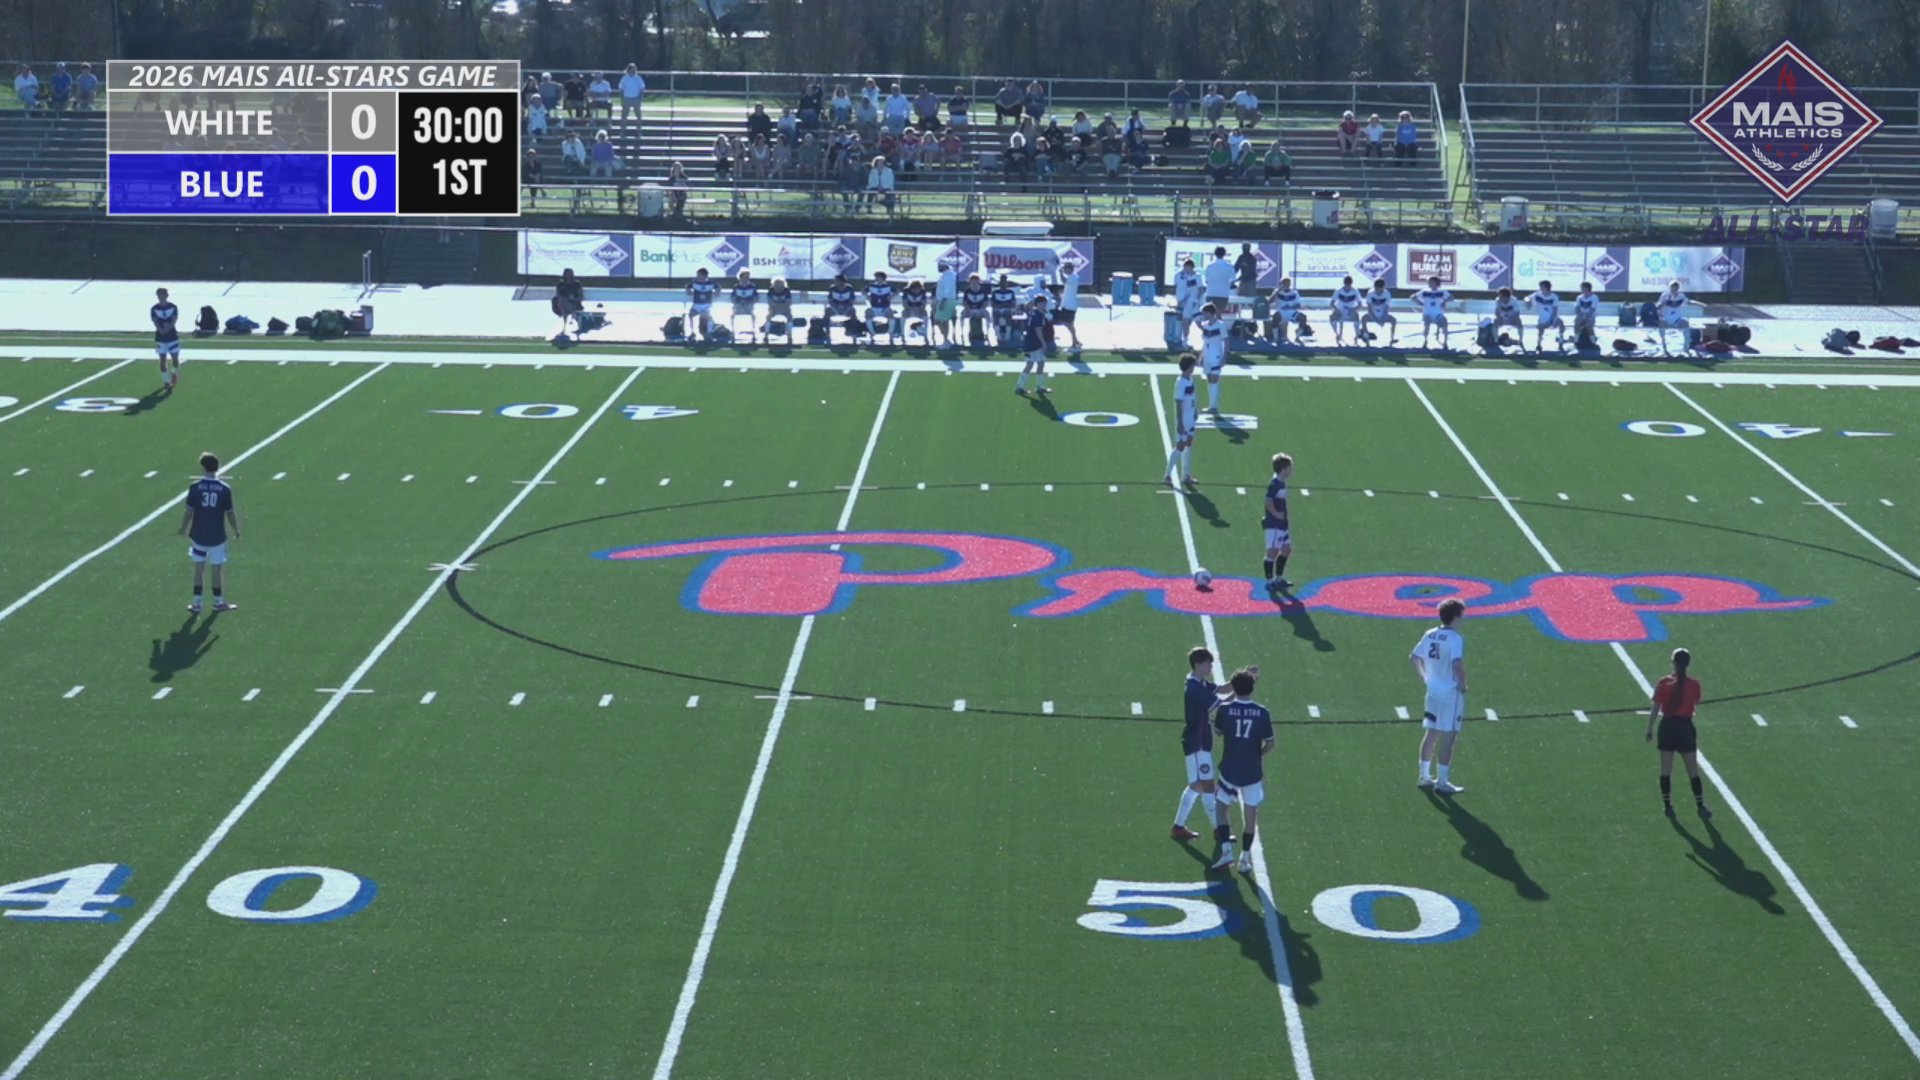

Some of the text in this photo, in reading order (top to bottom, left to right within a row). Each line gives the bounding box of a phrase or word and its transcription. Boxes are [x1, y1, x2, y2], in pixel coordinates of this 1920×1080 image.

[753, 257, 776, 266] BSN
[985, 254, 1046, 270] Wilson
[1423, 254, 1451, 262] FARM
[1412, 262, 1453, 272] BUREAU
[201, 492, 217, 507] 30
[592, 531, 1828, 643] Prep
[1429, 642, 1440, 660] 21
[1229, 708, 1261, 717] ALL STAR
[1234, 719, 1252, 738] 17
